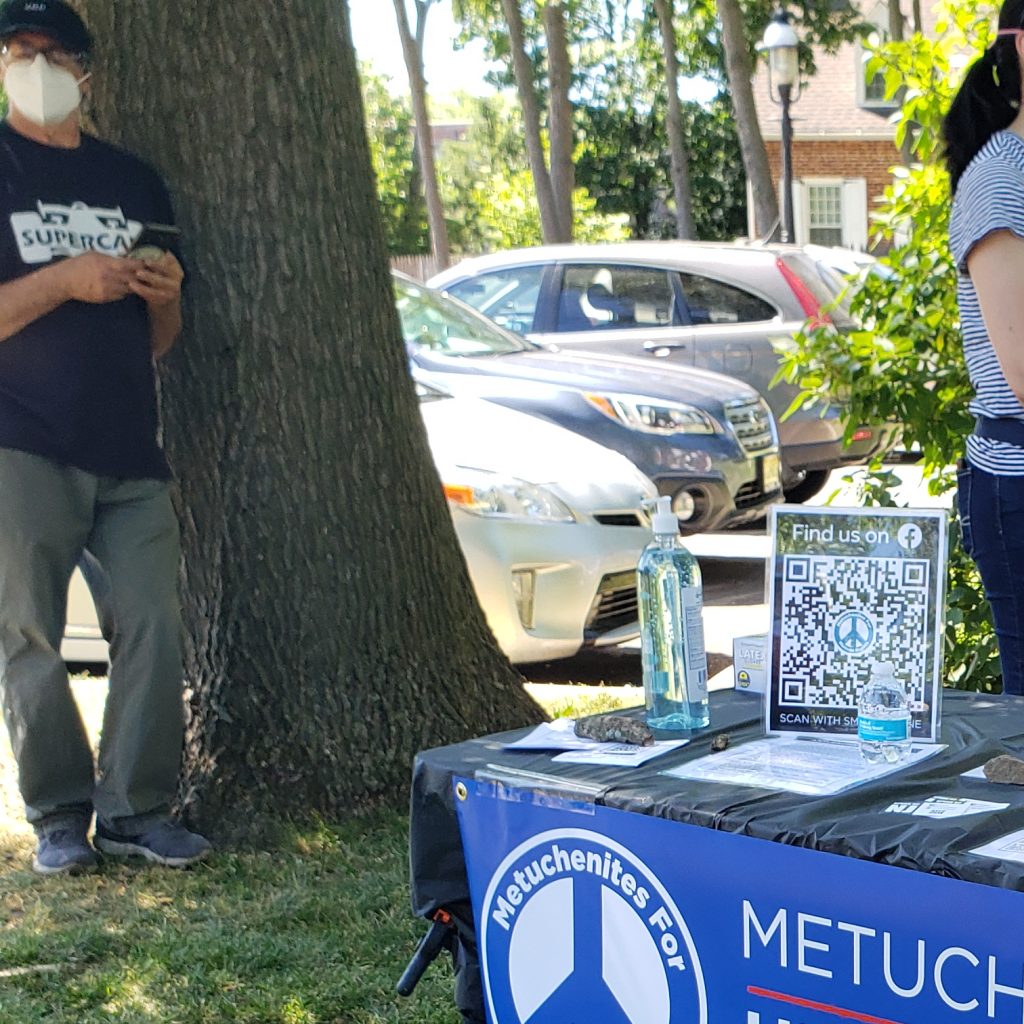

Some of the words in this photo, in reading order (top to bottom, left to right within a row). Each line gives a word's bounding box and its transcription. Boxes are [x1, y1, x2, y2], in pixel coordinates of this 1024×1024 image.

[792, 523, 834, 542] Find
[839, 529, 860, 543] us
[865, 530, 889, 544] on
[779, 713, 810, 723] SCAN
[813, 715, 841, 726] WITH
[492, 844, 650, 931] Metuchenites
[649, 906, 685, 972] For
